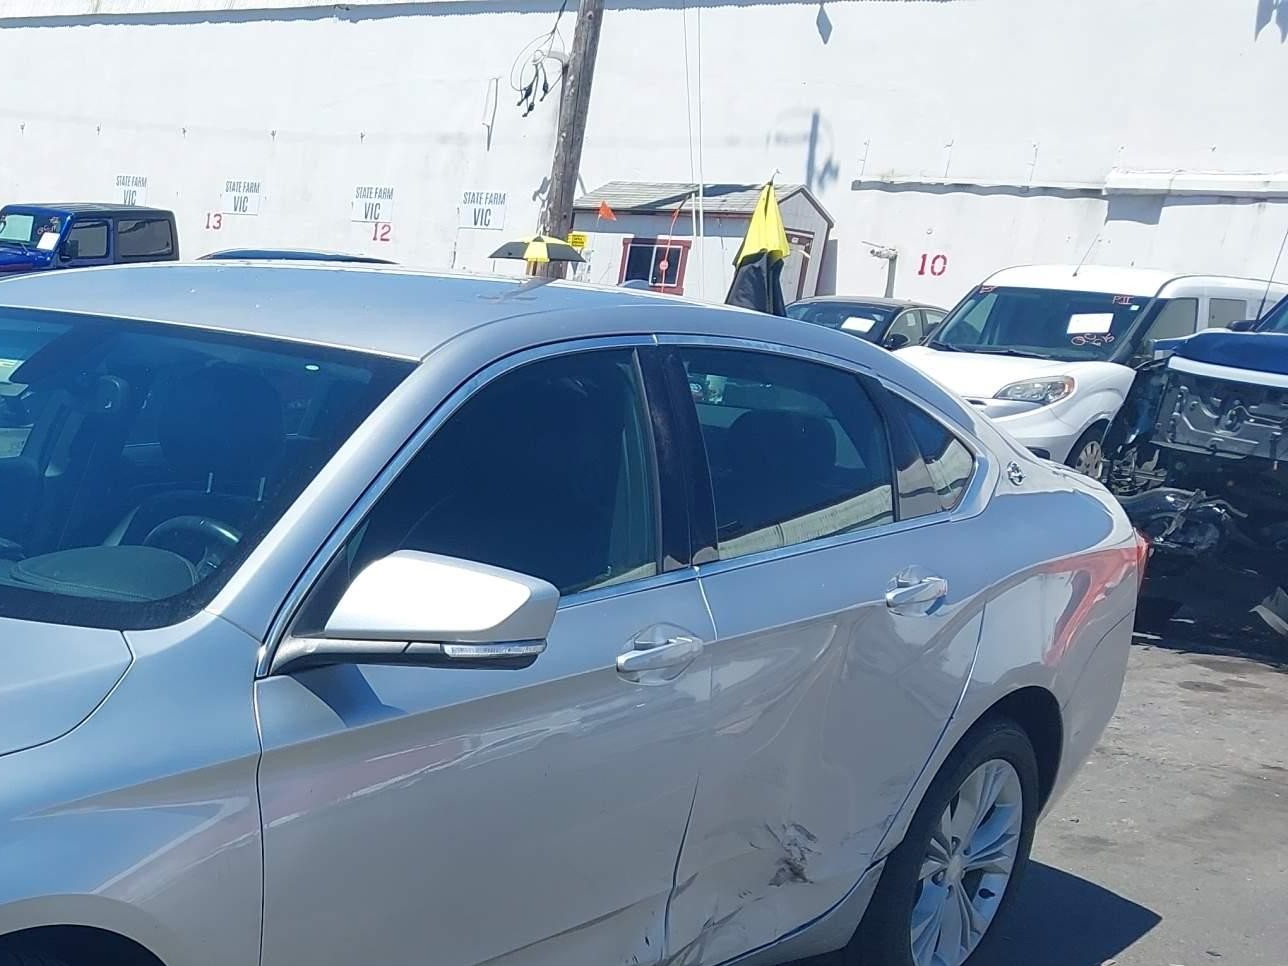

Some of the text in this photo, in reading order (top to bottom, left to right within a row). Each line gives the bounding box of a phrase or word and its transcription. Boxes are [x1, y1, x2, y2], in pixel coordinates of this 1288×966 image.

[116, 175, 147, 188] STATE FARM
[225, 181, 260, 193] STATE FARM
[123, 189, 137, 206] VIC
[355, 187, 394, 200] STATE FARM
[463, 192, 506, 205] STATE FARM
[233, 195, 249, 213] VIC
[364, 202, 381, 220] VIC
[205, 213, 222, 230] 13
[473, 207, 491, 227] VIC
[372, 223, 392, 242] 12
[918, 253, 948, 276] 10
